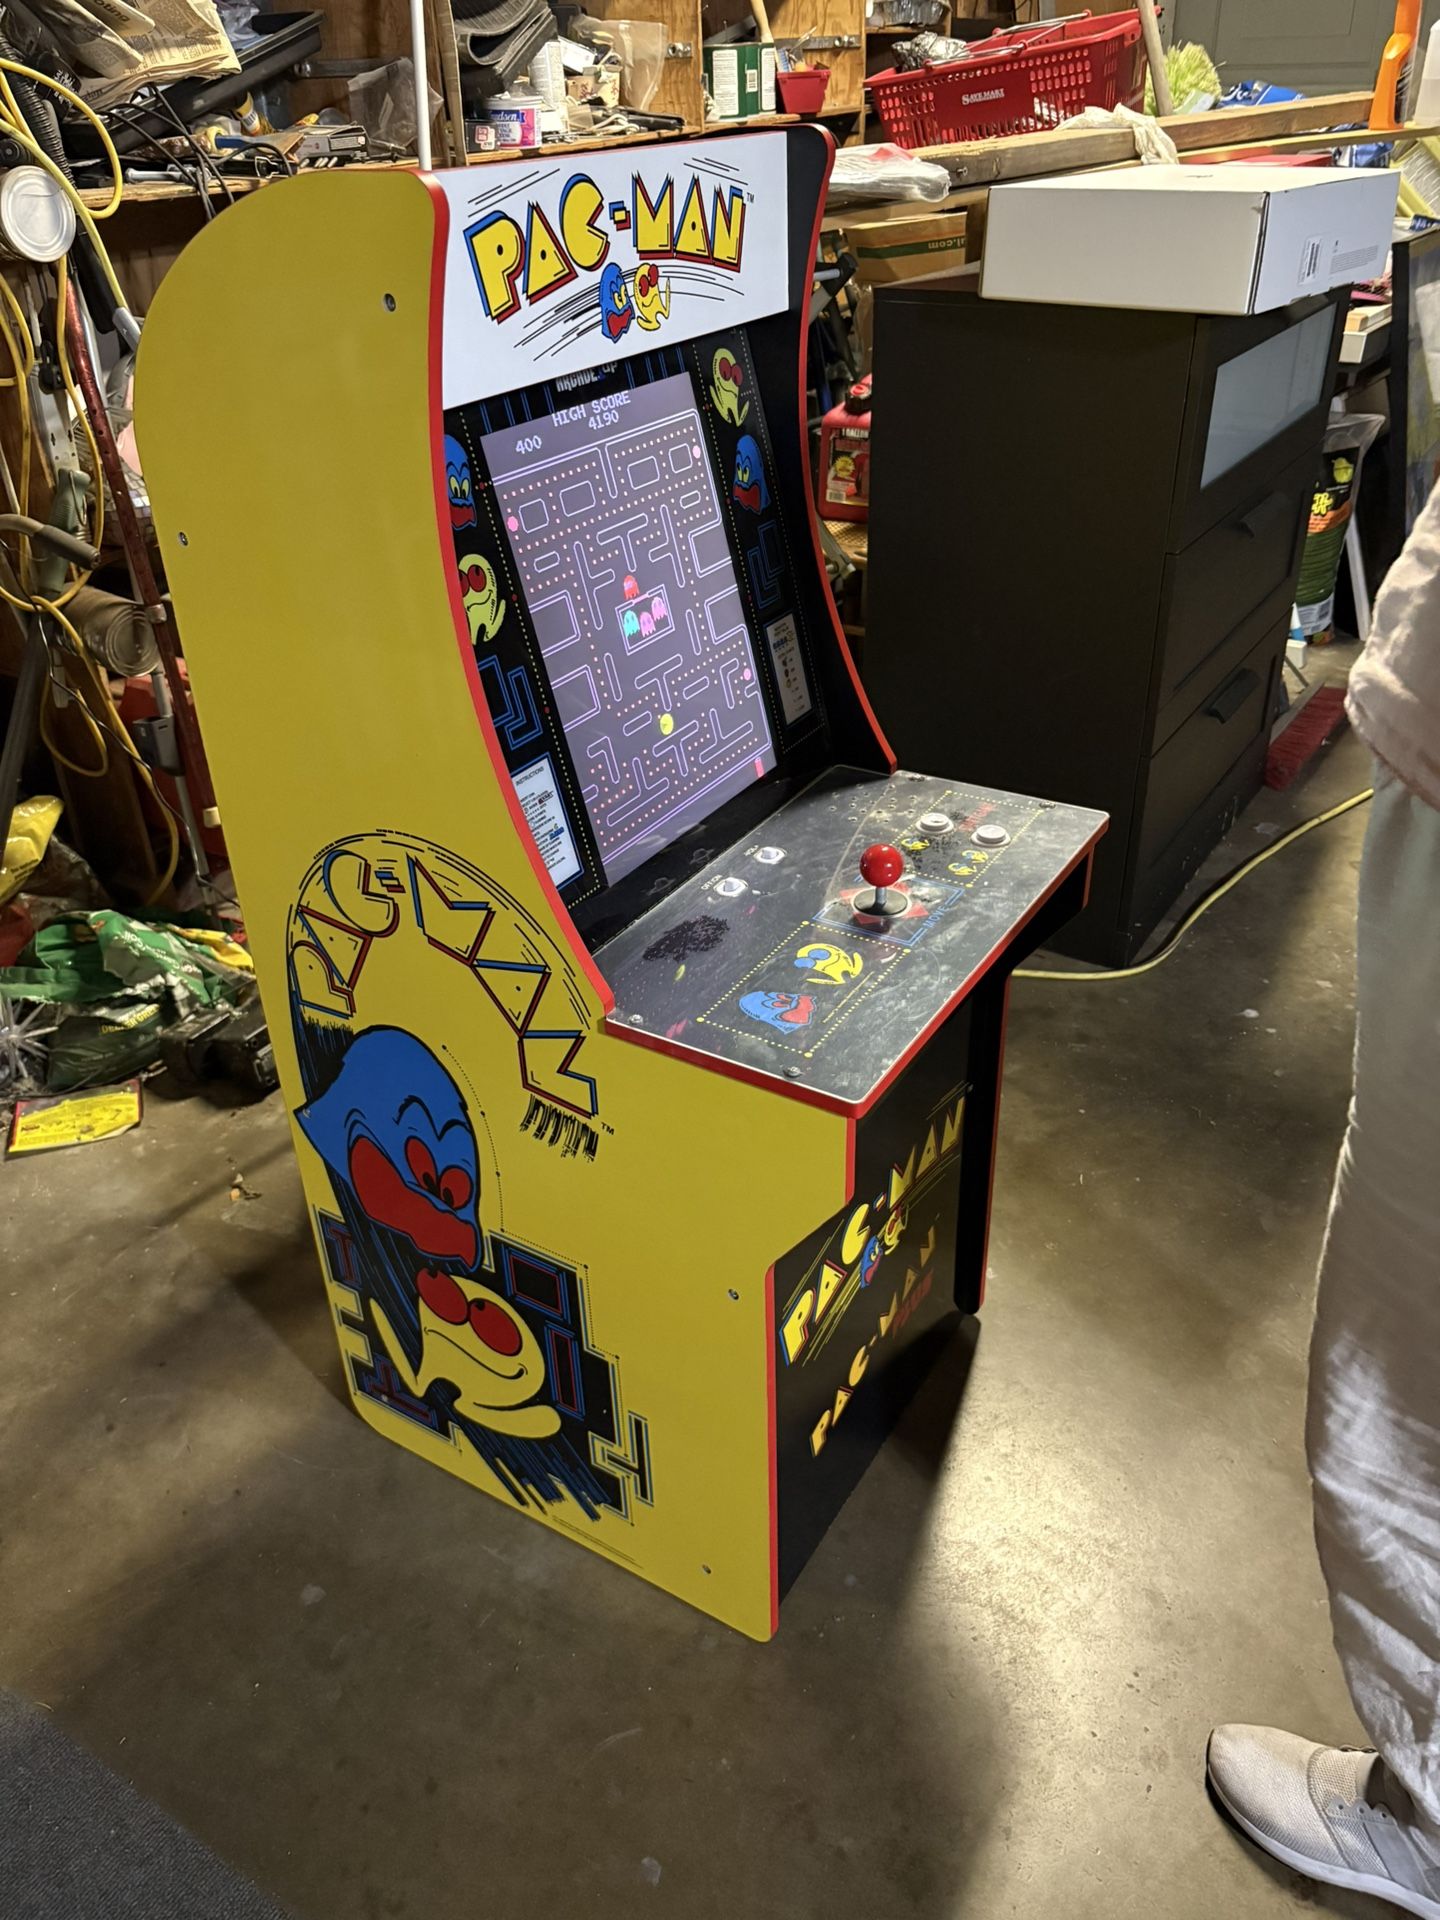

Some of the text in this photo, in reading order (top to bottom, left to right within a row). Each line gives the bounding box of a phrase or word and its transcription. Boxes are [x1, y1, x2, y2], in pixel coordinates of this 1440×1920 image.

[464, 170, 746, 325] PAC-MAN
[515, 435, 542, 454] 400
[551, 390, 631, 427] HIGH SCORE
[588, 409, 619, 430] 4190
[288, 849, 599, 1120] PAC-MAN
[779, 1096, 965, 1367] PAC-MAN
